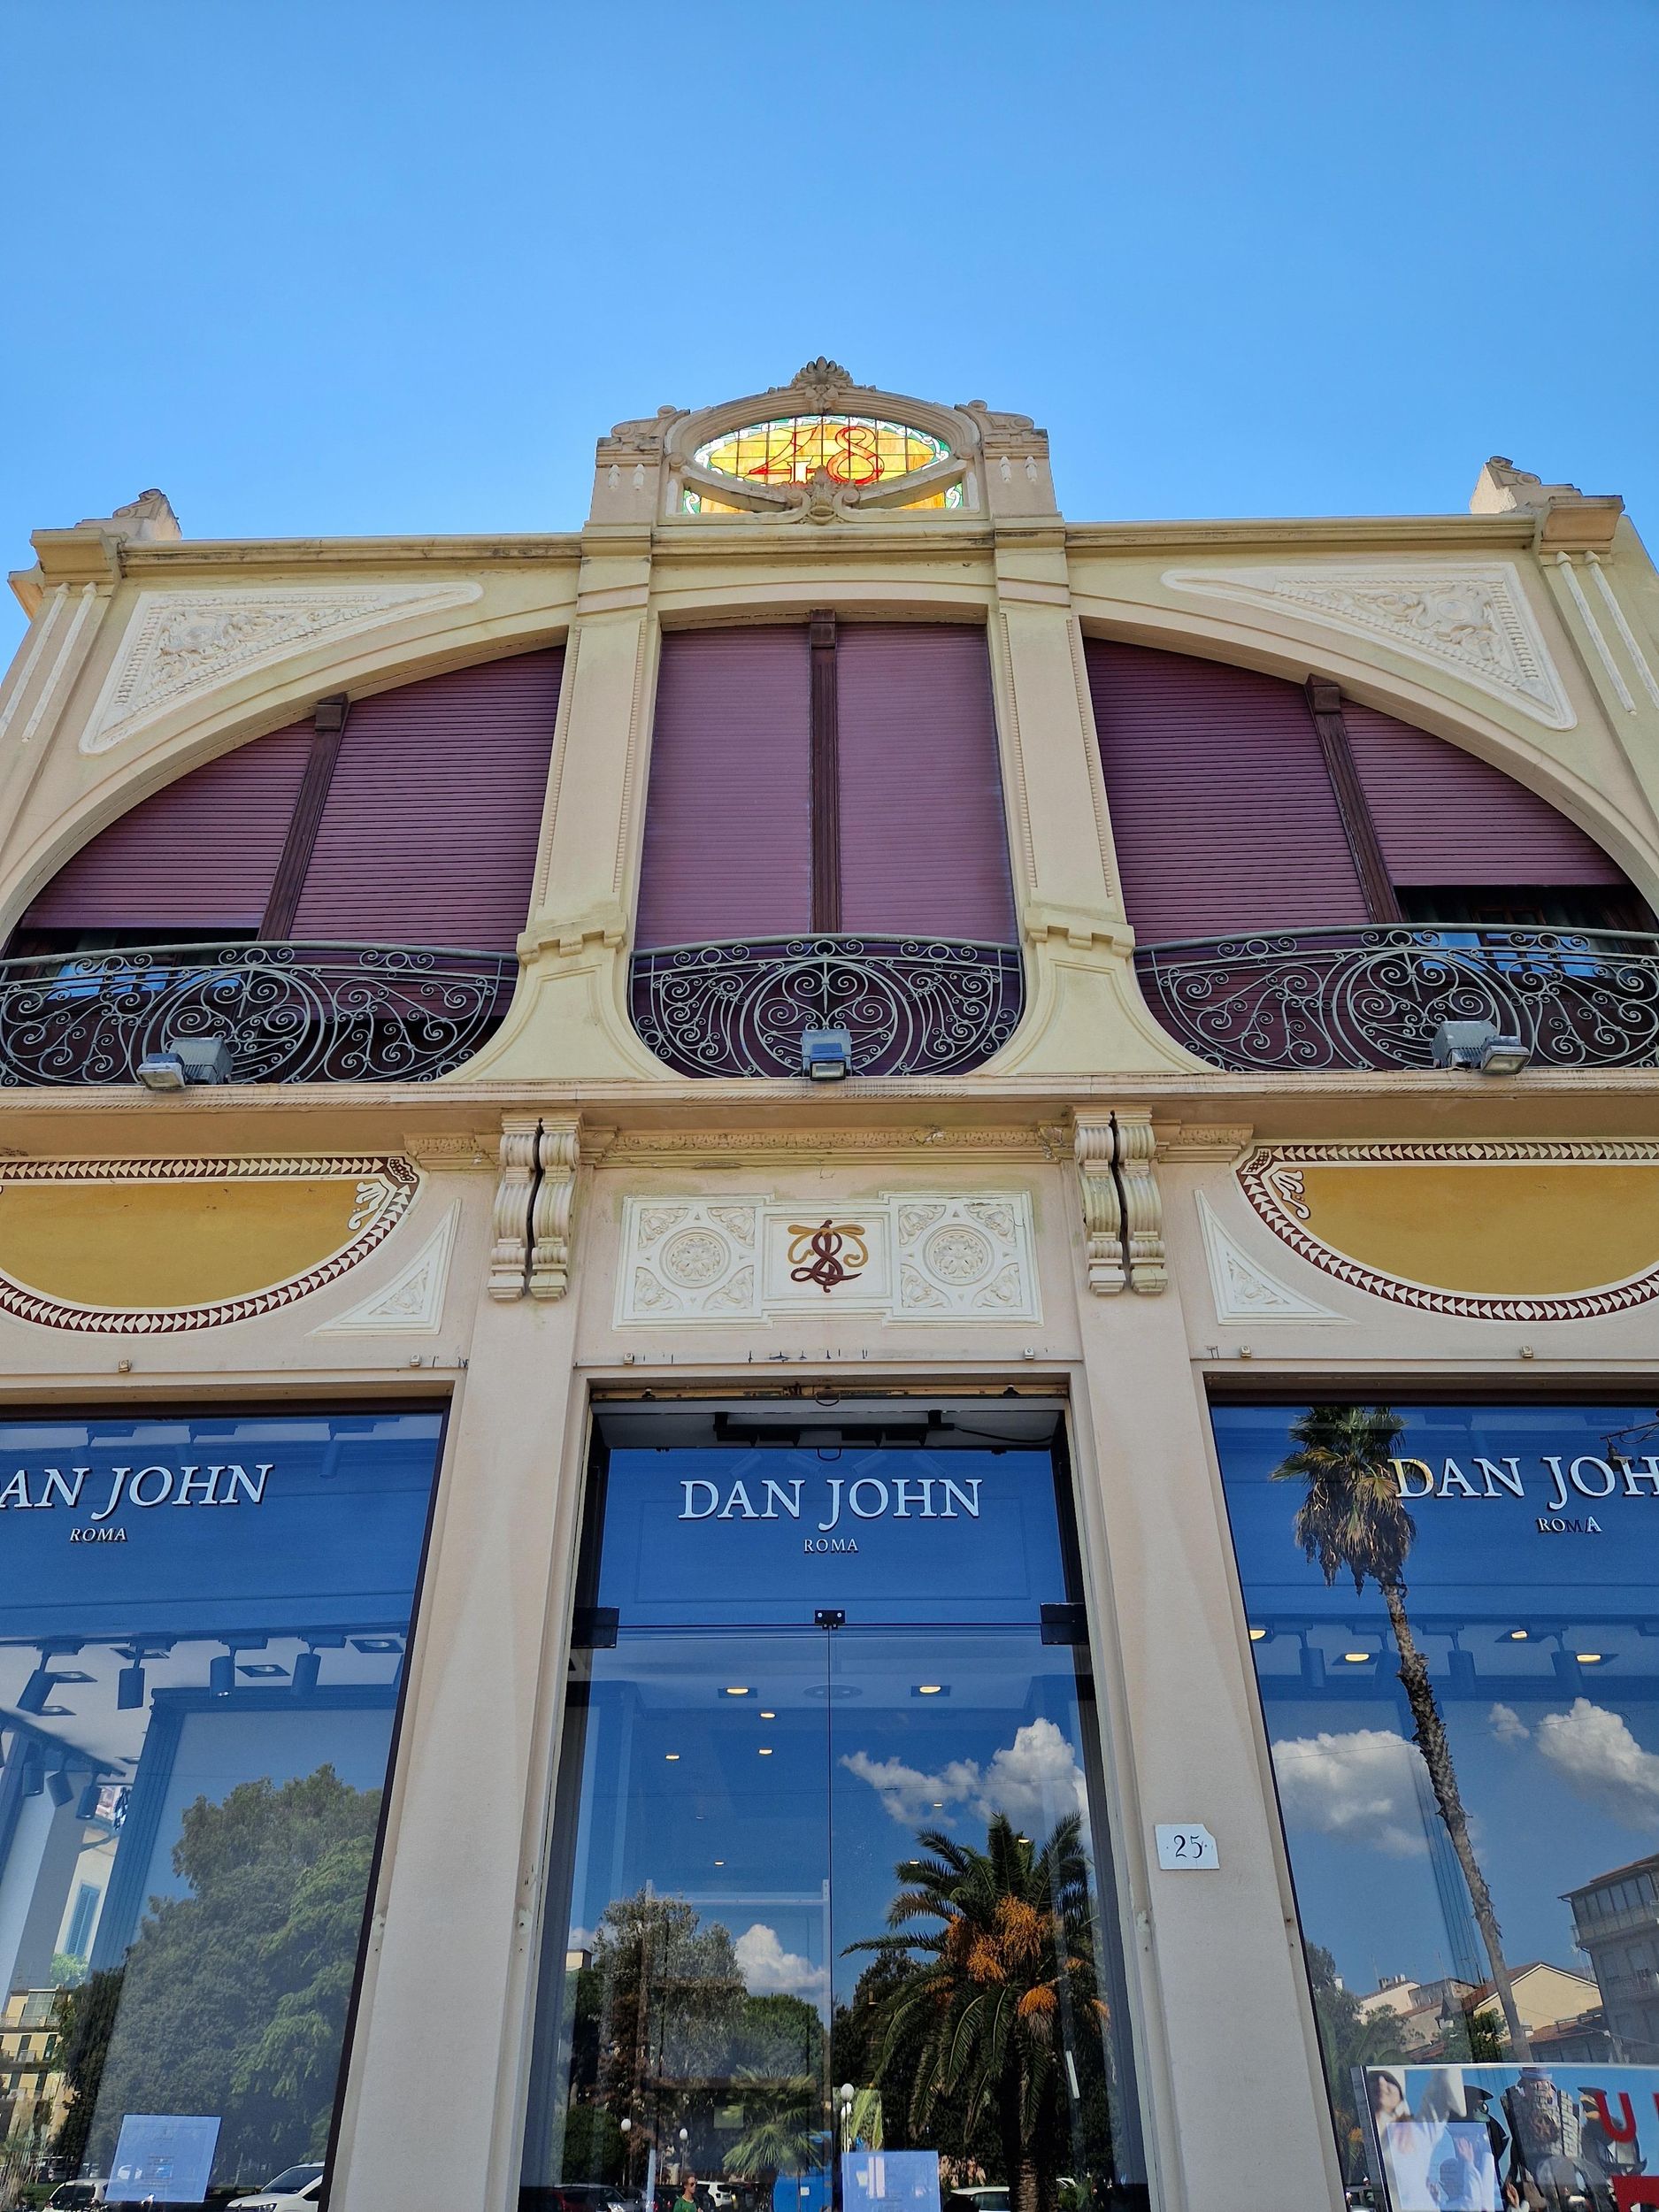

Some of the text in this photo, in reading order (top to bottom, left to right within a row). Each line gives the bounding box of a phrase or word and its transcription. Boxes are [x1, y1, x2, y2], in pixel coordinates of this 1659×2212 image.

[749, 425, 884, 485] 48
[90, 1464, 273, 1520] JOHN
[1387, 1457, 1525, 1498] DAN
[678, 1479, 982, 1531] DAN JOHN
[70, 1527, 127, 1542] ROMA
[803, 1538, 859, 1553] ROMA
[1173, 1834, 1203, 1859] 25
